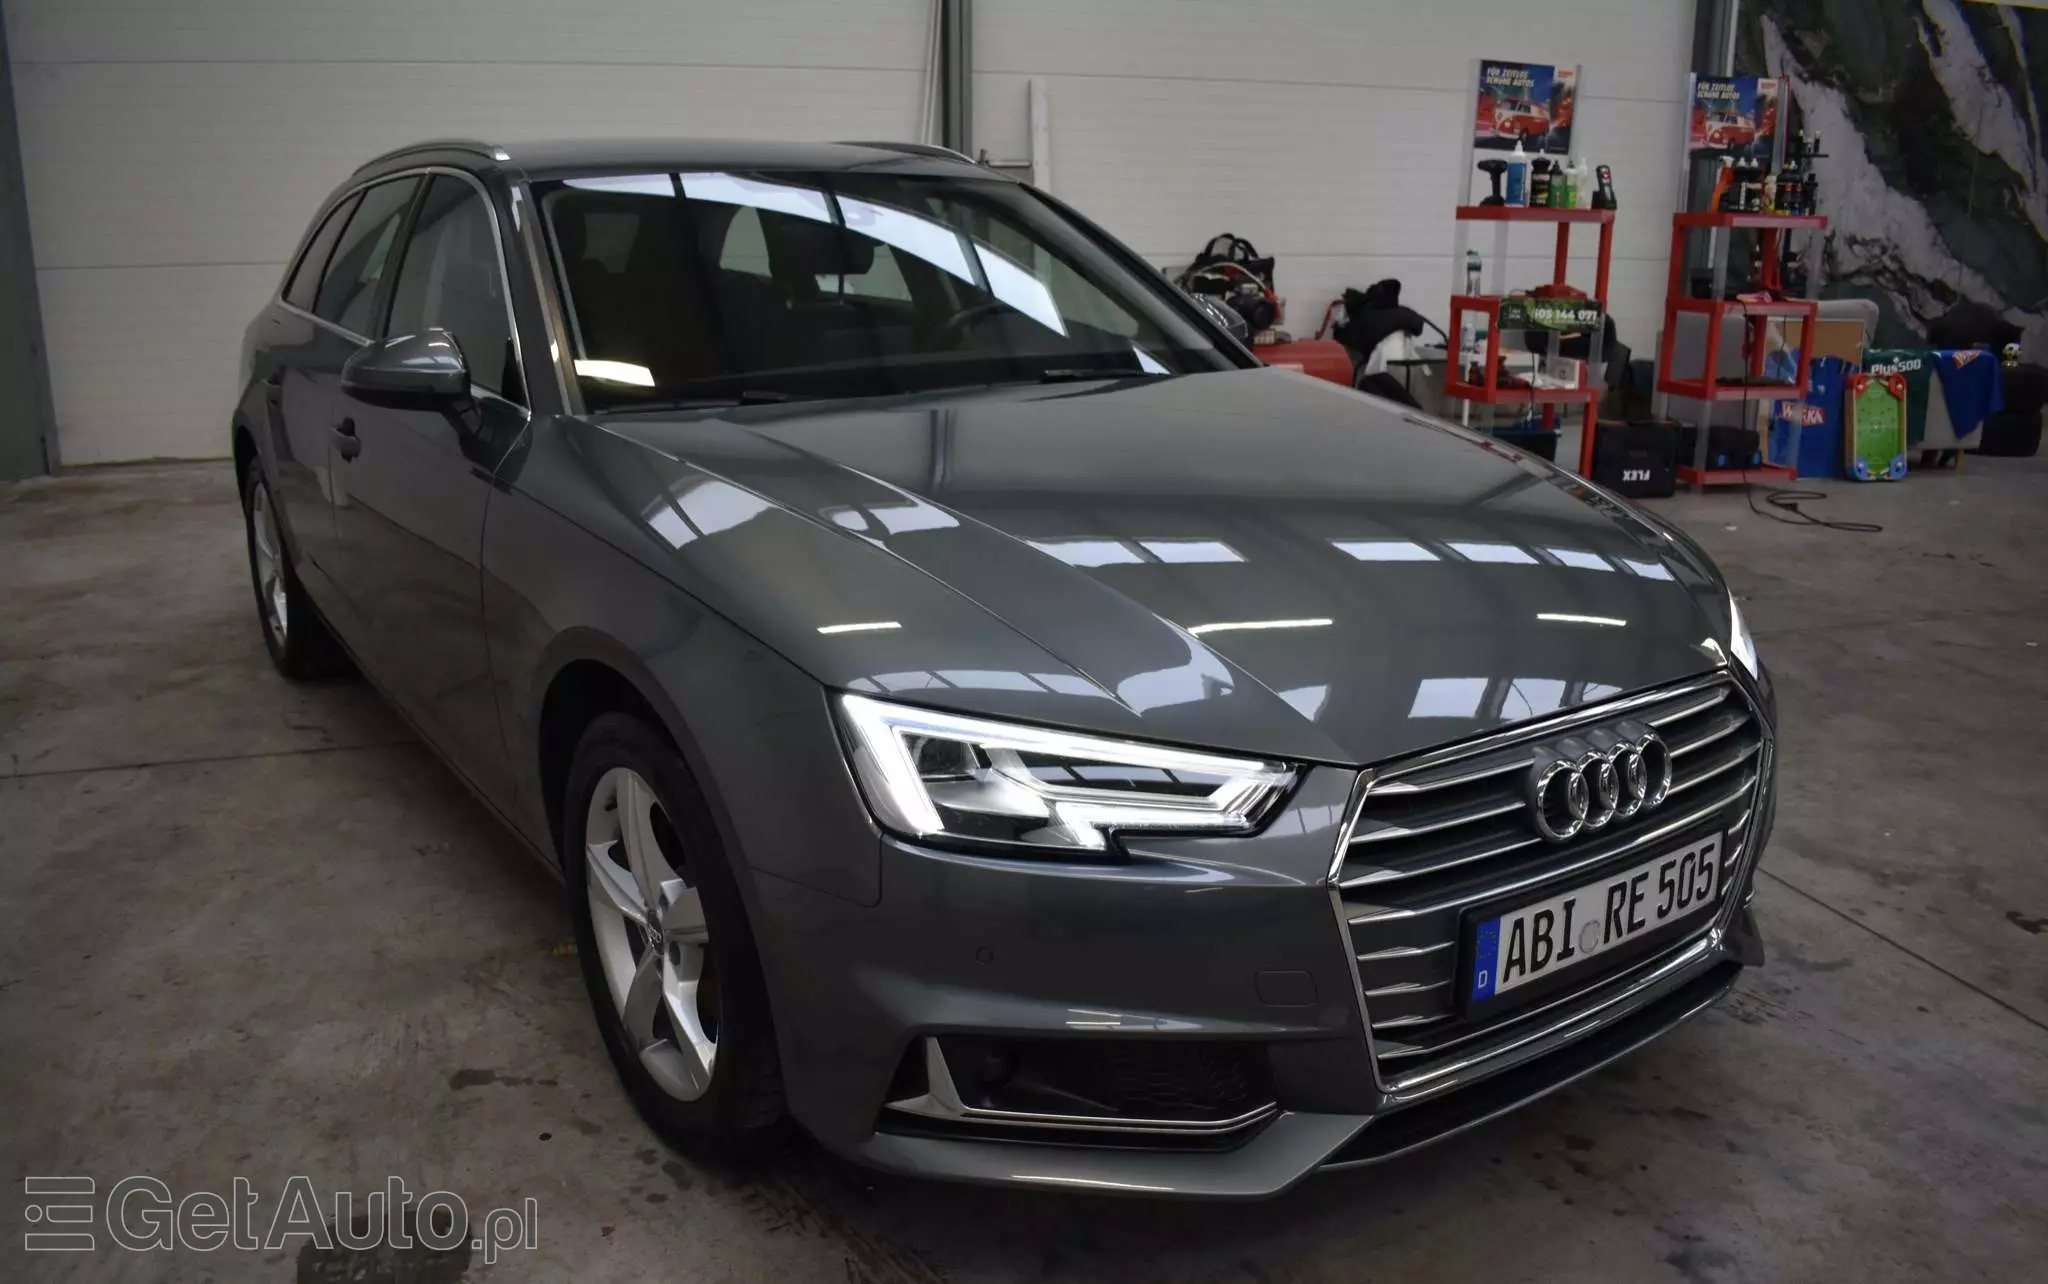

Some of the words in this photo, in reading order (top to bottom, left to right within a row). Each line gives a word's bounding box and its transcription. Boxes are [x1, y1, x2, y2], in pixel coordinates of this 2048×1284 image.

[1622, 469, 1651, 481] FLEX
[1503, 898, 1577, 983] ABI
[1604, 871, 1650, 945] RE
[1657, 842, 1715, 919] 505
[1477, 970, 1488, 989] D
